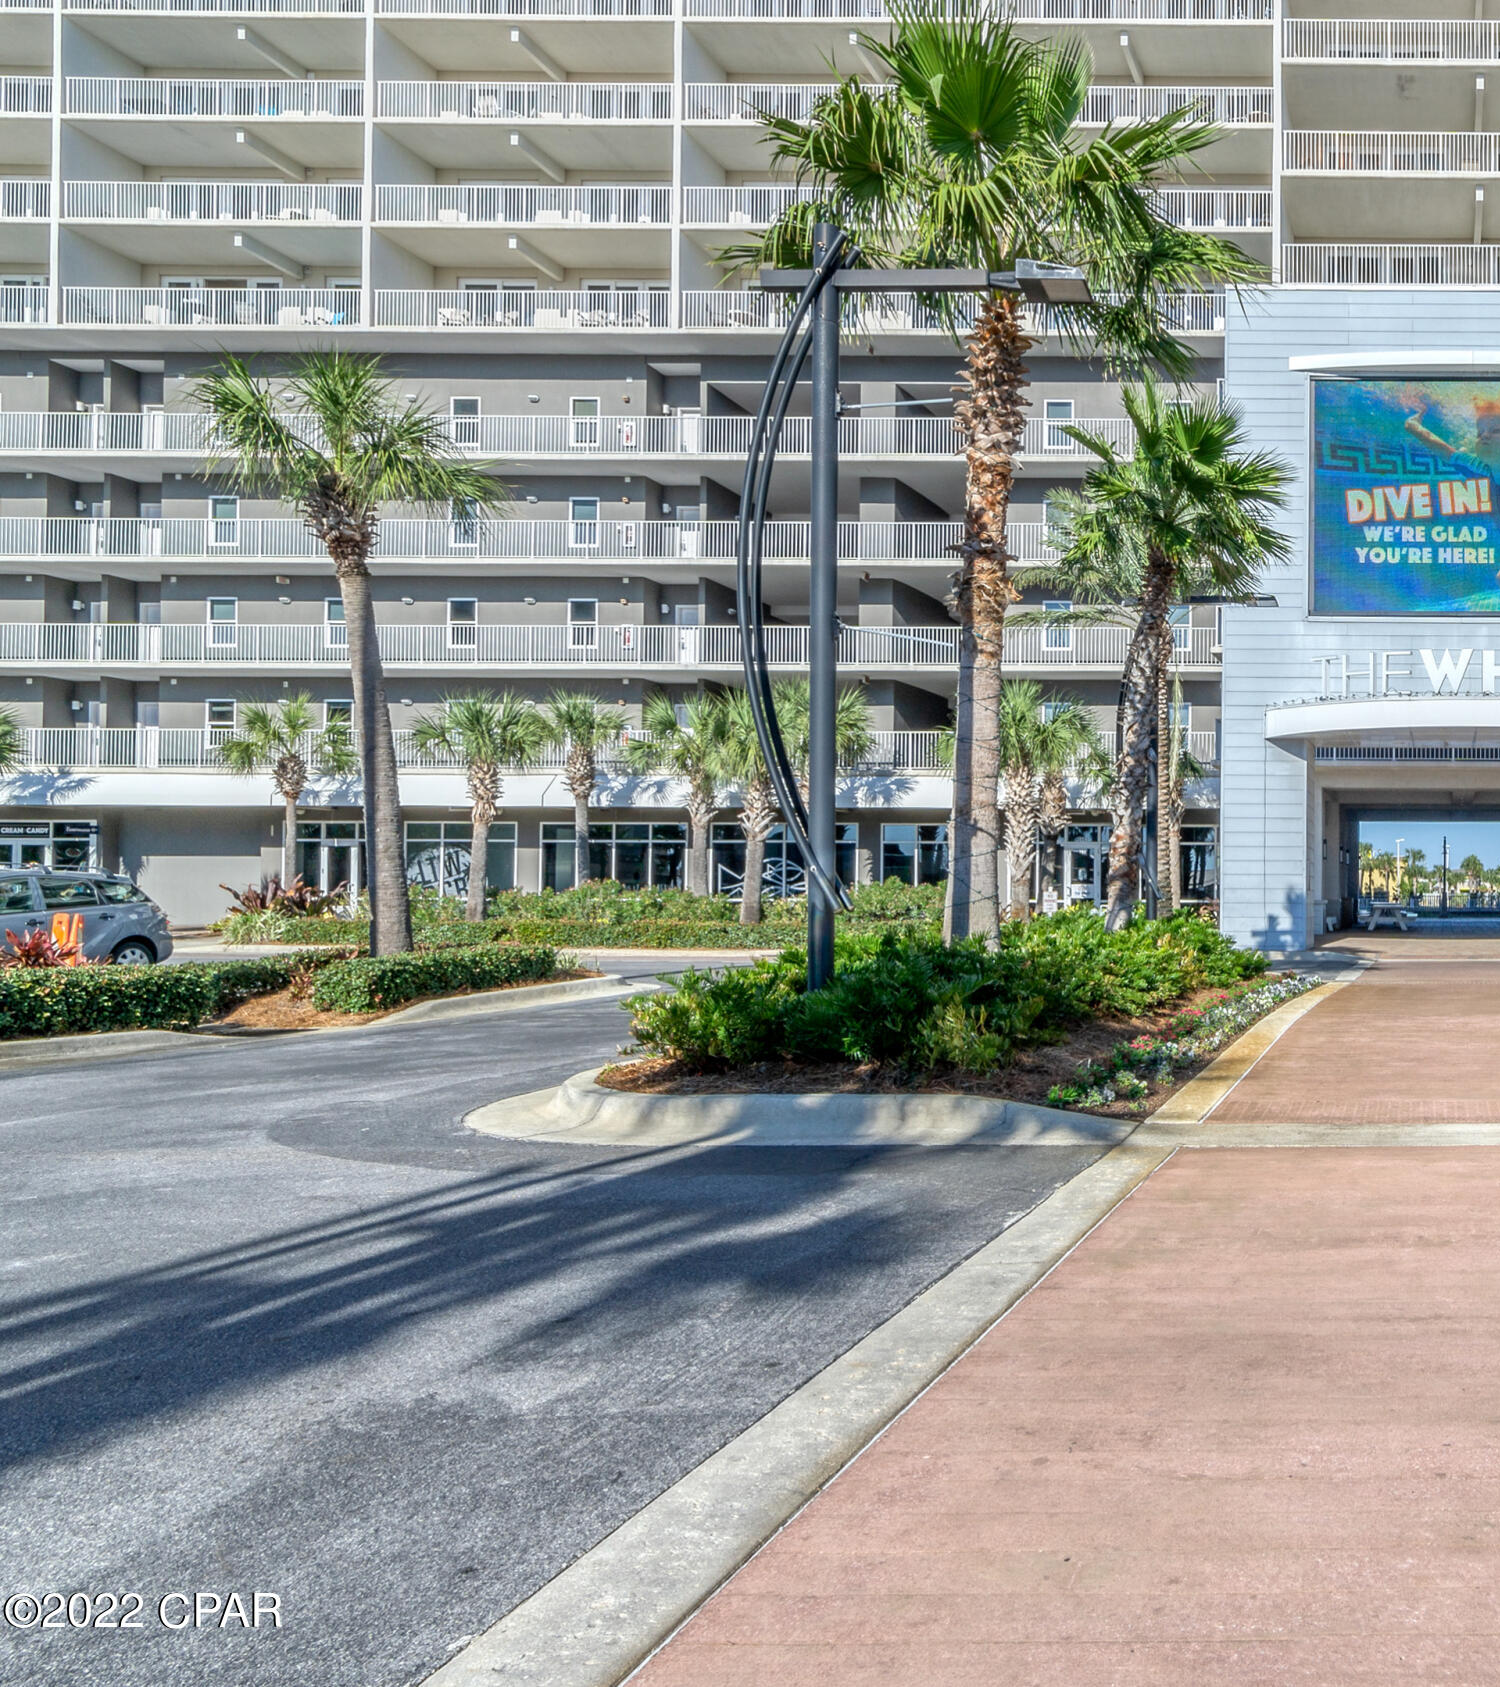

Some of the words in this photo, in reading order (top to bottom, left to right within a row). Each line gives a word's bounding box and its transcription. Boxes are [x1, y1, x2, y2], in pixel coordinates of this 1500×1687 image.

[1345, 484, 1432, 523] DIVE
[1438, 478, 1492, 515] IN!
[1363, 526, 1426, 542] WE'RE
[1431, 526, 1487, 542] GLAD
[1355, 547, 1432, 564] YOU'RE
[1438, 547, 1495, 564] HERE!
[1312, 650, 1412, 699] THE
